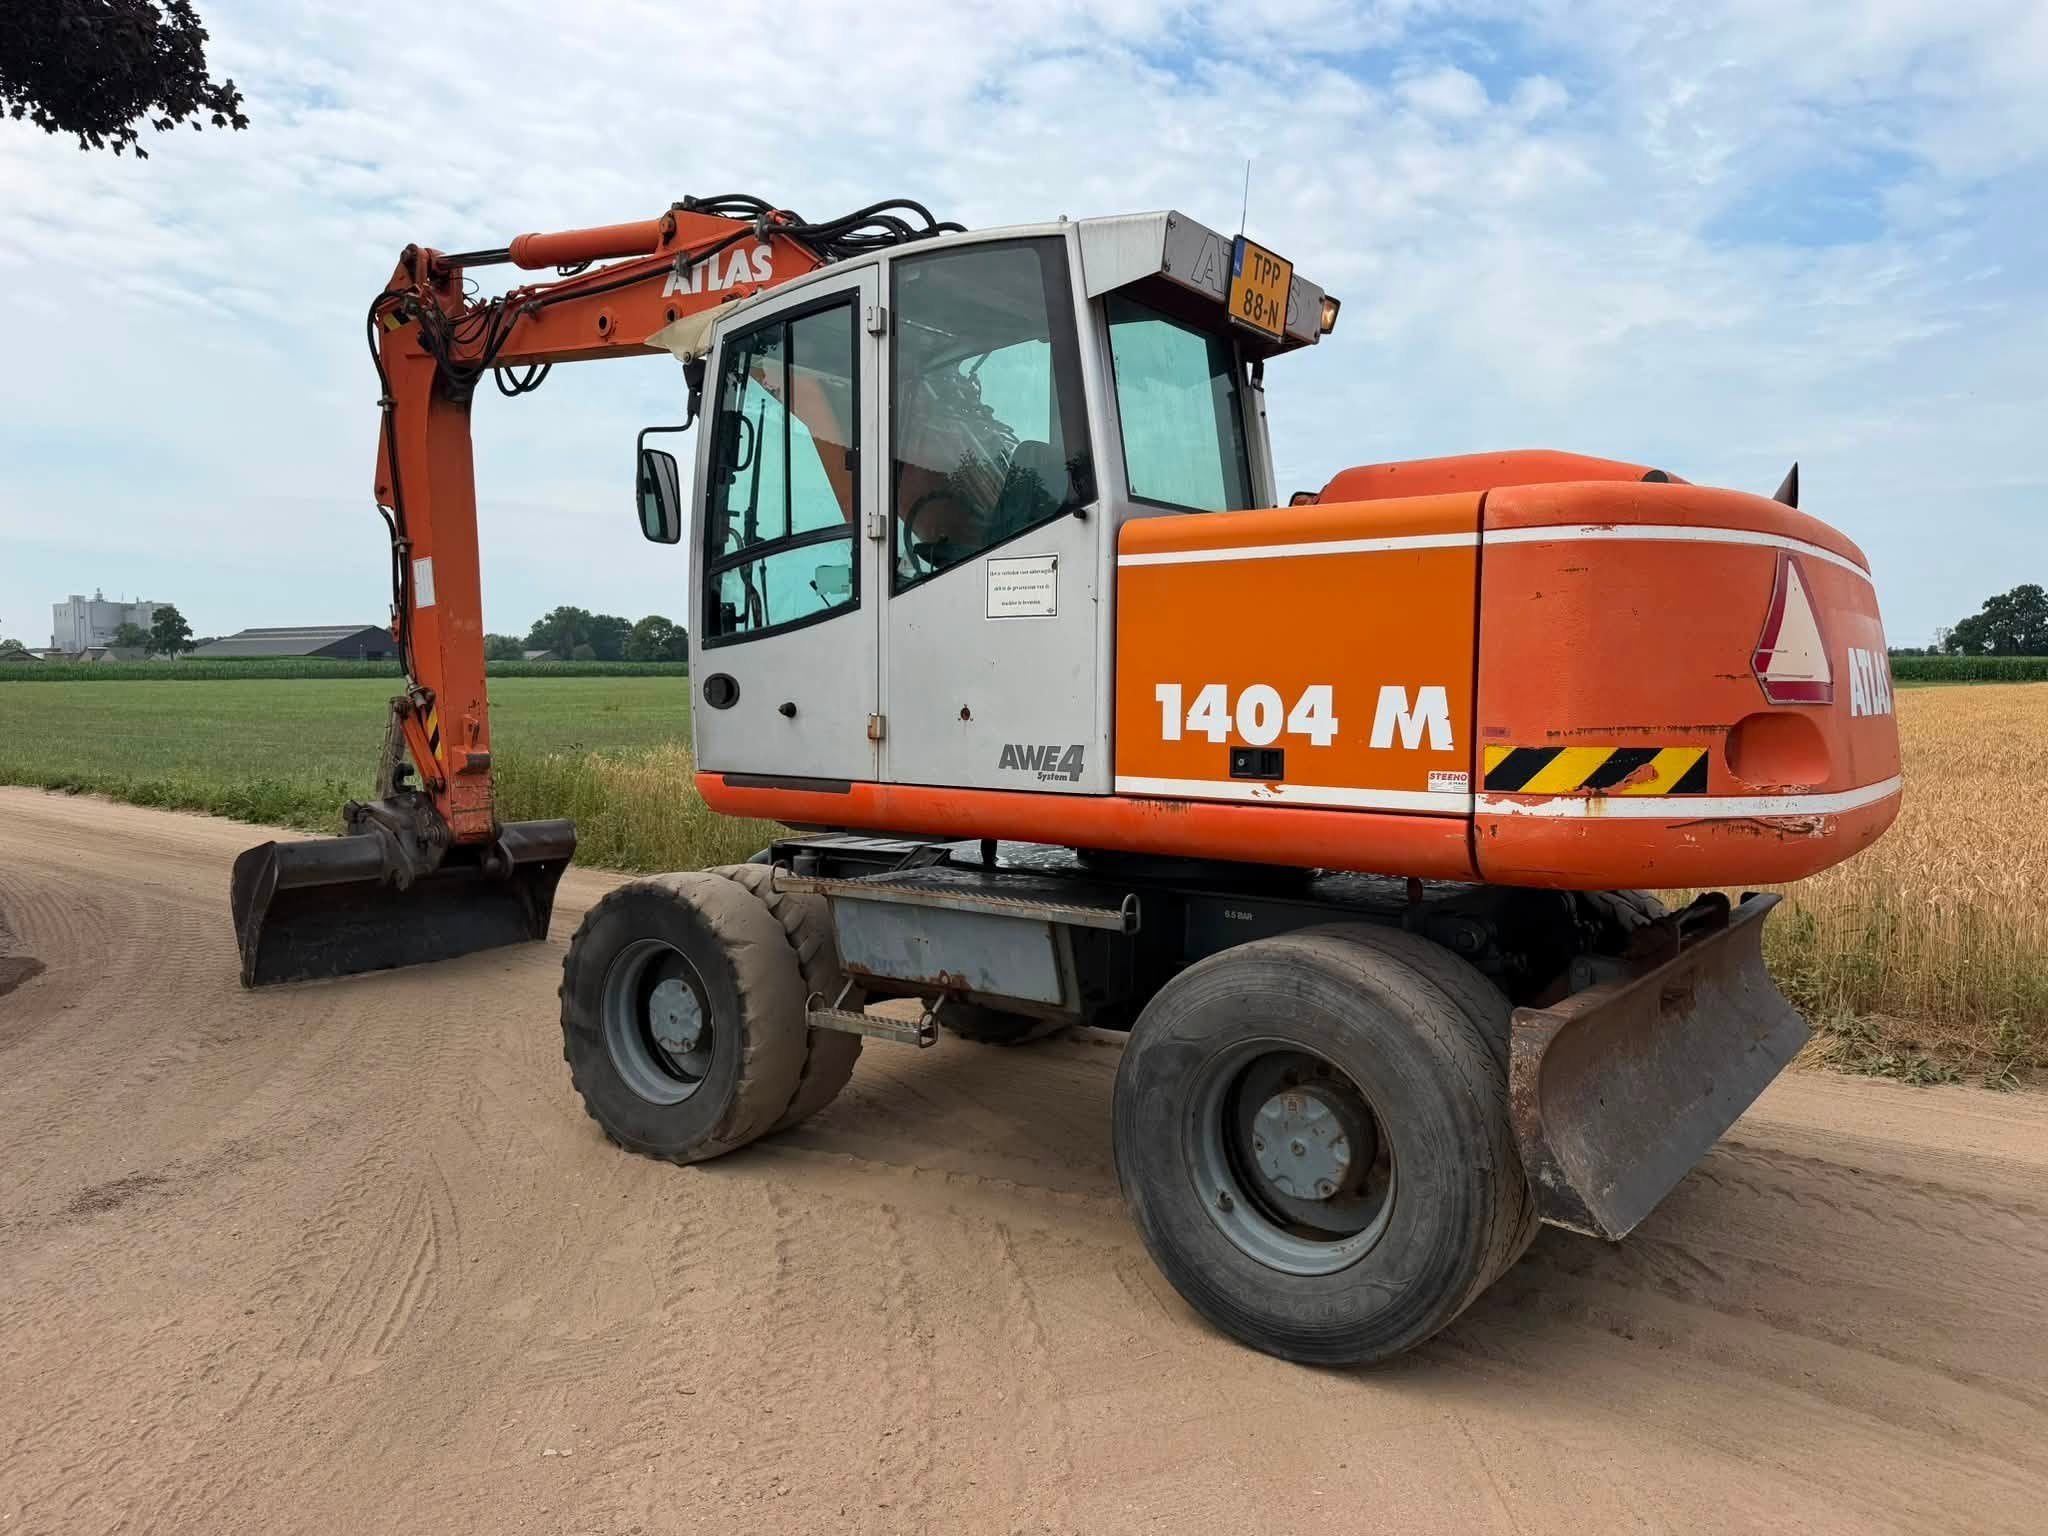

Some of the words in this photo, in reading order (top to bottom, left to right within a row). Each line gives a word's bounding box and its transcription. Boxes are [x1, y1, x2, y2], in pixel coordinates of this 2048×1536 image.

[661, 244, 773, 298] ATLAS
[1254, 252, 1280, 288] TPP
[1244, 288, 1279, 328] 88-N
[1155, 683, 1339, 746] 1404
[1369, 685, 1455, 751] M
[998, 744, 1085, 782] AWE4
[1037, 771, 1068, 783] System
